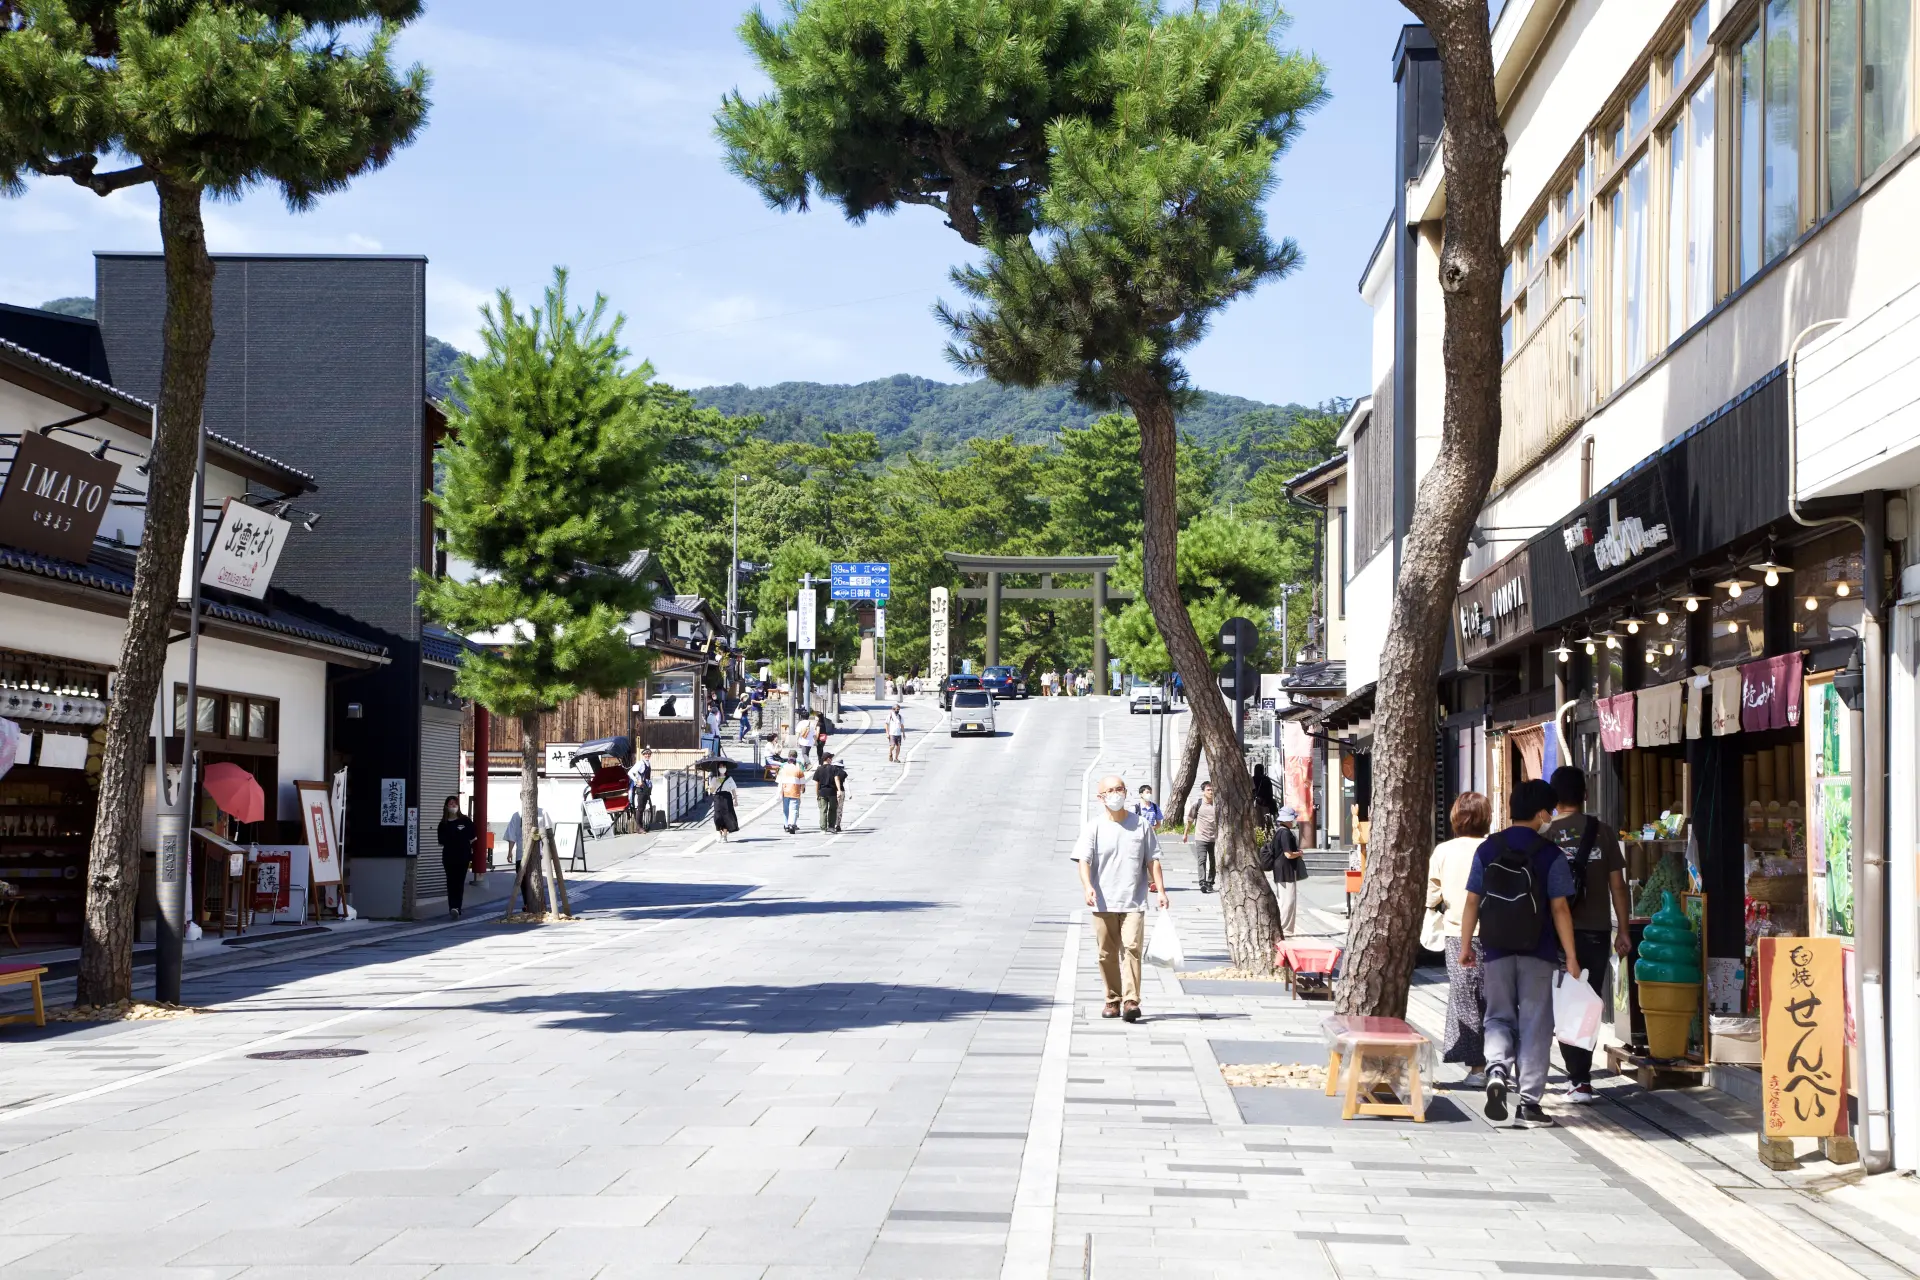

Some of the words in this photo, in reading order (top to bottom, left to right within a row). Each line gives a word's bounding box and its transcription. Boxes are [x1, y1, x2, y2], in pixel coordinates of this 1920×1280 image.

[21, 463, 102, 512] IMAYO
[33, 510, 72, 532] いまよう
[932, 597, 947, 676] 出雲大社
